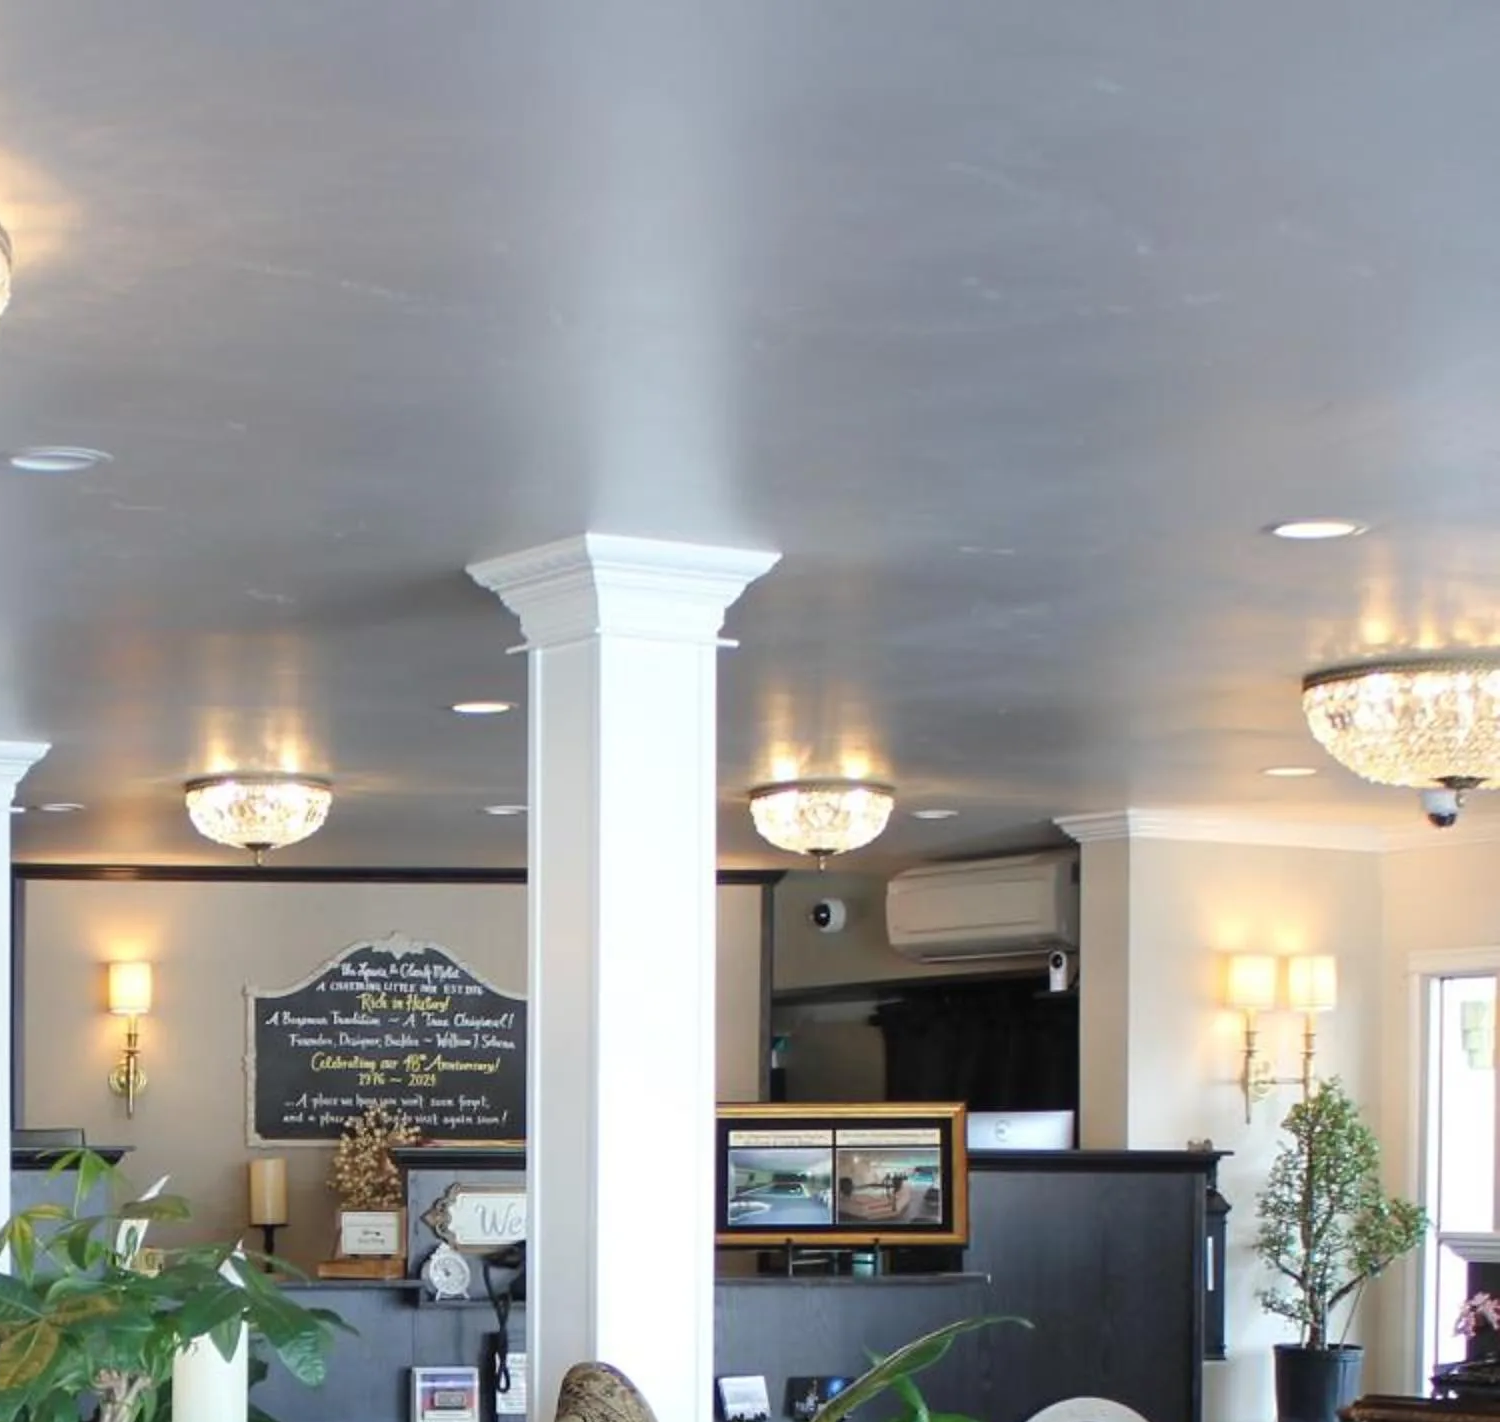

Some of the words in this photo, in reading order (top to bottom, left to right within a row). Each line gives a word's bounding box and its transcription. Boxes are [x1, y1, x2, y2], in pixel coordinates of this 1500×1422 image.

[265, 1011, 279, 1026] A
[402, 1012, 416, 1028] A
[311, 1051, 377, 1072] Celebrating
[380, 1058, 399, 1070] our
[283, 1112, 304, 1123] and
